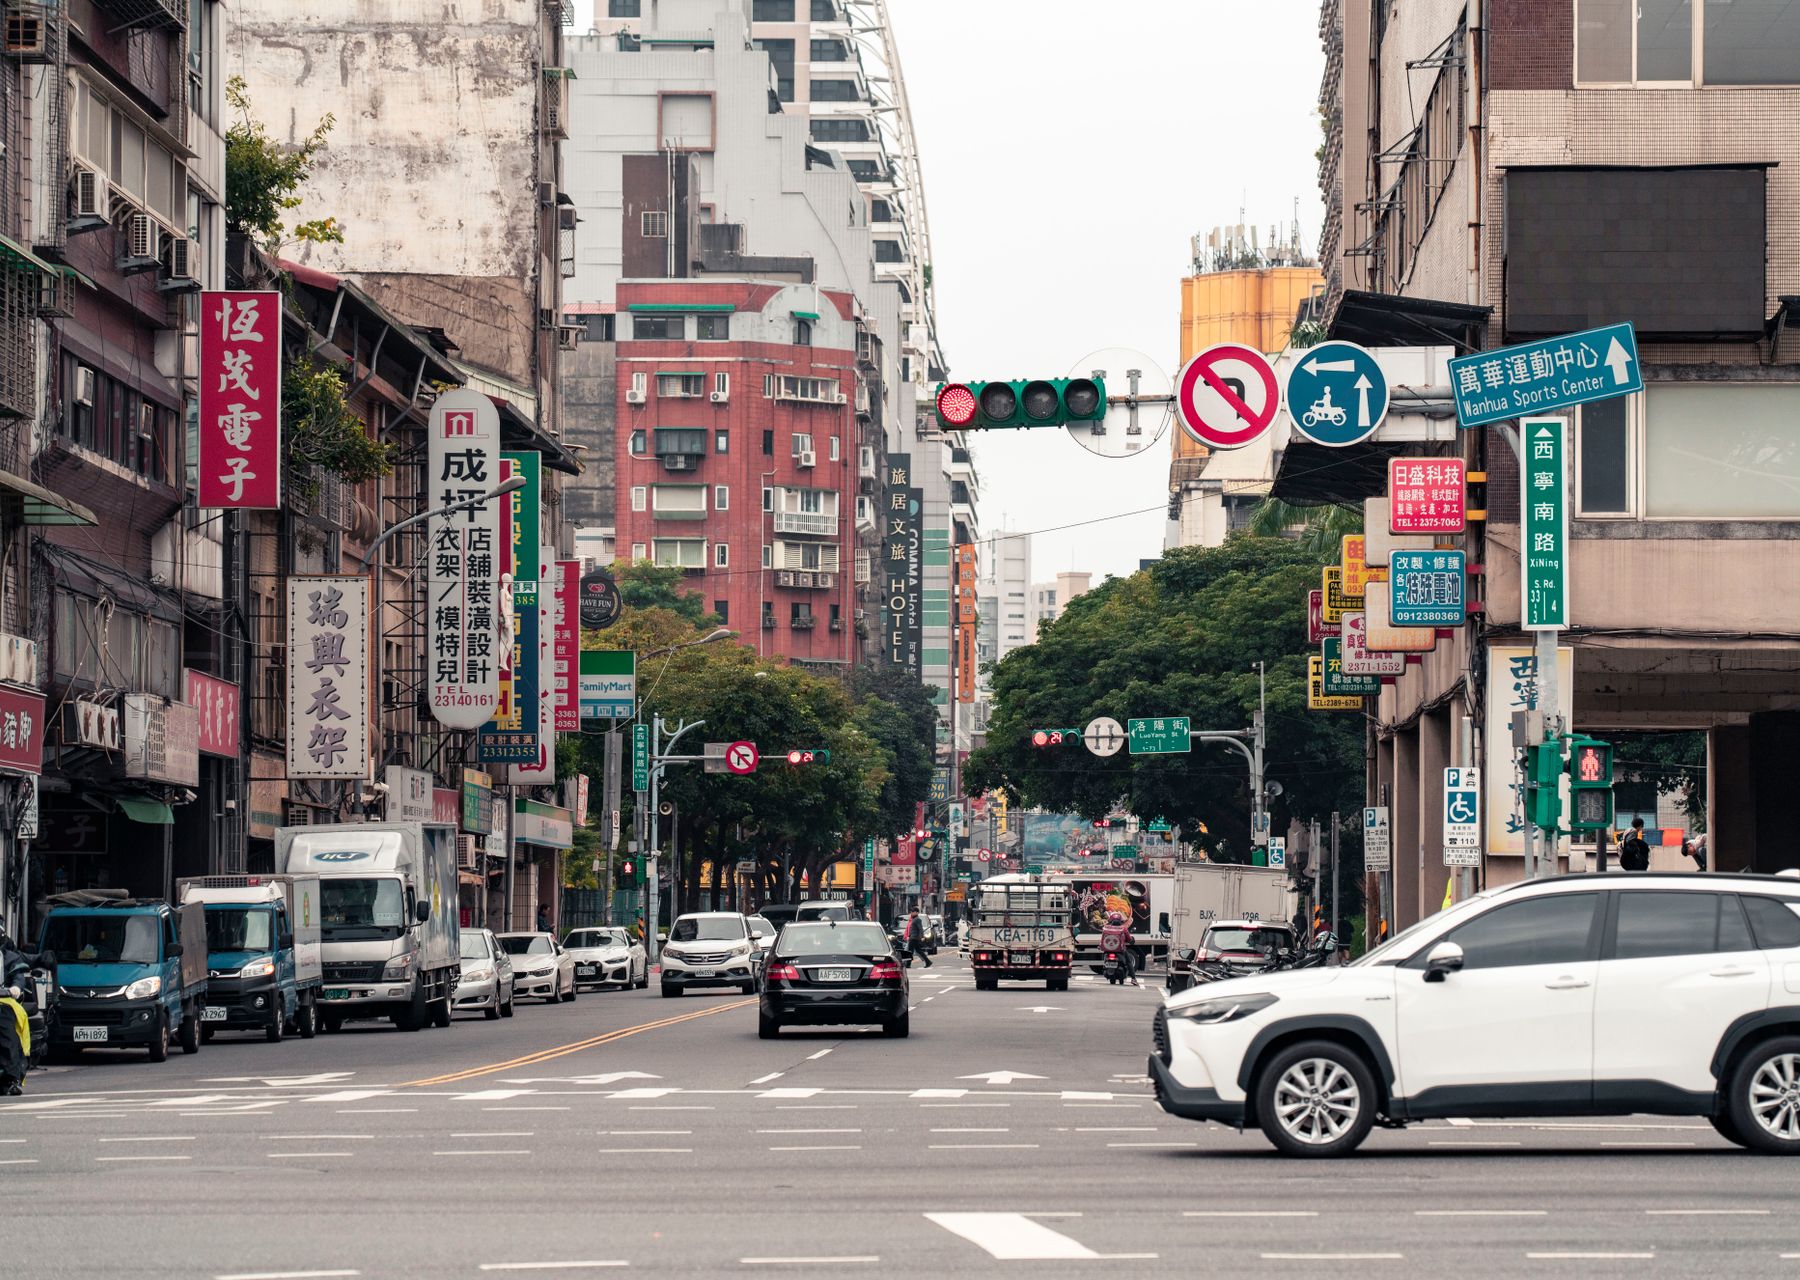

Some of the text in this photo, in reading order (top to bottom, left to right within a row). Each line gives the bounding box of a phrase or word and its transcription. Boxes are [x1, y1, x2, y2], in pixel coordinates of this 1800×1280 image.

[1456, 342, 1599, 397] 萬華運動中心
[215, 297, 263, 502] 恆茂電子
[1463, 375, 1604, 417] Wanhua Sports Center
[1395, 465, 1460, 486] 日盛科技
[441, 448, 488, 523] 成坪
[1533, 440, 1555, 552] 西寧南路
[891, 468, 907, 561] 旅居文旅
[909, 528, 919, 587] COMMA
[1530, 558, 1559, 569] XiNing
[1406, 572, 1461, 605] 特殊電池
[1544, 579, 1556, 589] Rd.
[466, 527, 492, 684] 店舖裝潢設計
[598, 600, 612, 608] FUN
[909, 593, 918, 629] Hotel
[890, 579, 907, 663] HOTEL
[1397, 612, 1460, 620] 0912380369
[305, 585, 351, 769] 瑞興衣架
[435, 686, 469, 694] TEL
[580, 682, 632, 693] FamilyMart
[435, 694, 494, 706] 23140161
[1135, 719, 1183, 732] 洛陽街
[1051, 731, 1062, 744] 24
[483, 747, 536, 757] 23312355
[803, 752, 814, 762] 24
[994, 928, 1055, 943] KEA-1169
[74, 1030, 107, 1040] APH-1892
